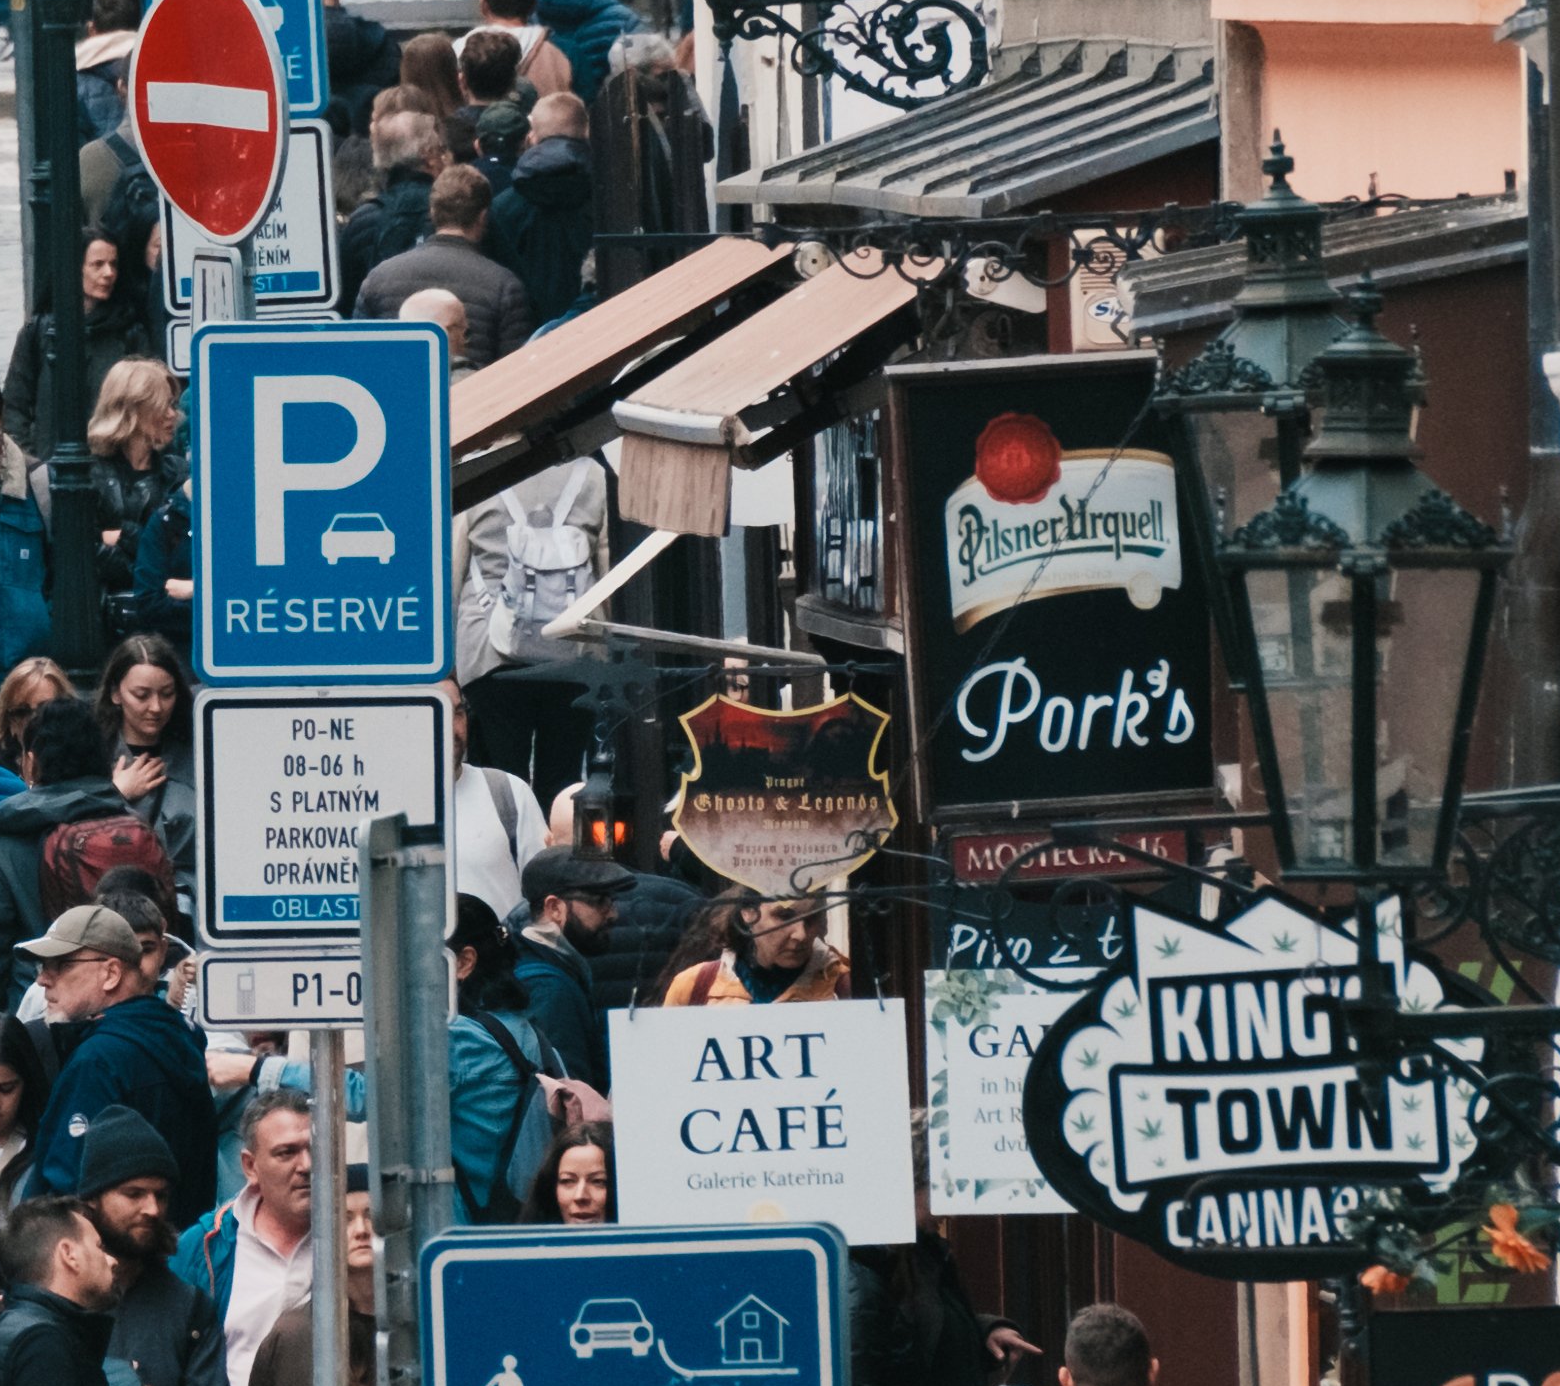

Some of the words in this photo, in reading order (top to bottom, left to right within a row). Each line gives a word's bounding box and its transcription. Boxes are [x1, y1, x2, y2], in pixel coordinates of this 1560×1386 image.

[253, 374, 387, 566] P
[957, 503, 1065, 588] Pilsner
[1058, 493, 1164, 561] Urquell
[225, 585, 420, 633] RÉSERVÉ
[956, 656, 1196, 763] Pork's
[291, 718, 355, 741] PO-NE
[283, 754, 344, 777] 08-06
[353, 754, 365, 777] h
[269, 790, 282, 813] S
[292, 783, 380, 813] PLATNÝM
[693, 793, 766, 813] Ghosts
[775, 795, 790, 812] &
[797, 793, 879, 813] Legends
[272, 897, 360, 918] OBLAST
[292, 971, 363, 1008] P1-0
[690, 1032, 827, 1083] ART
[981, 1076, 999, 1094] in
[679, 1087, 848, 1155] CAFÉ
[974, 1106, 1003, 1124] Art
[1164, 1082, 1393, 1162] TOWN
[686, 1171, 757, 1191] Galerie
[763, 1167, 845, 1188] Kateřina
